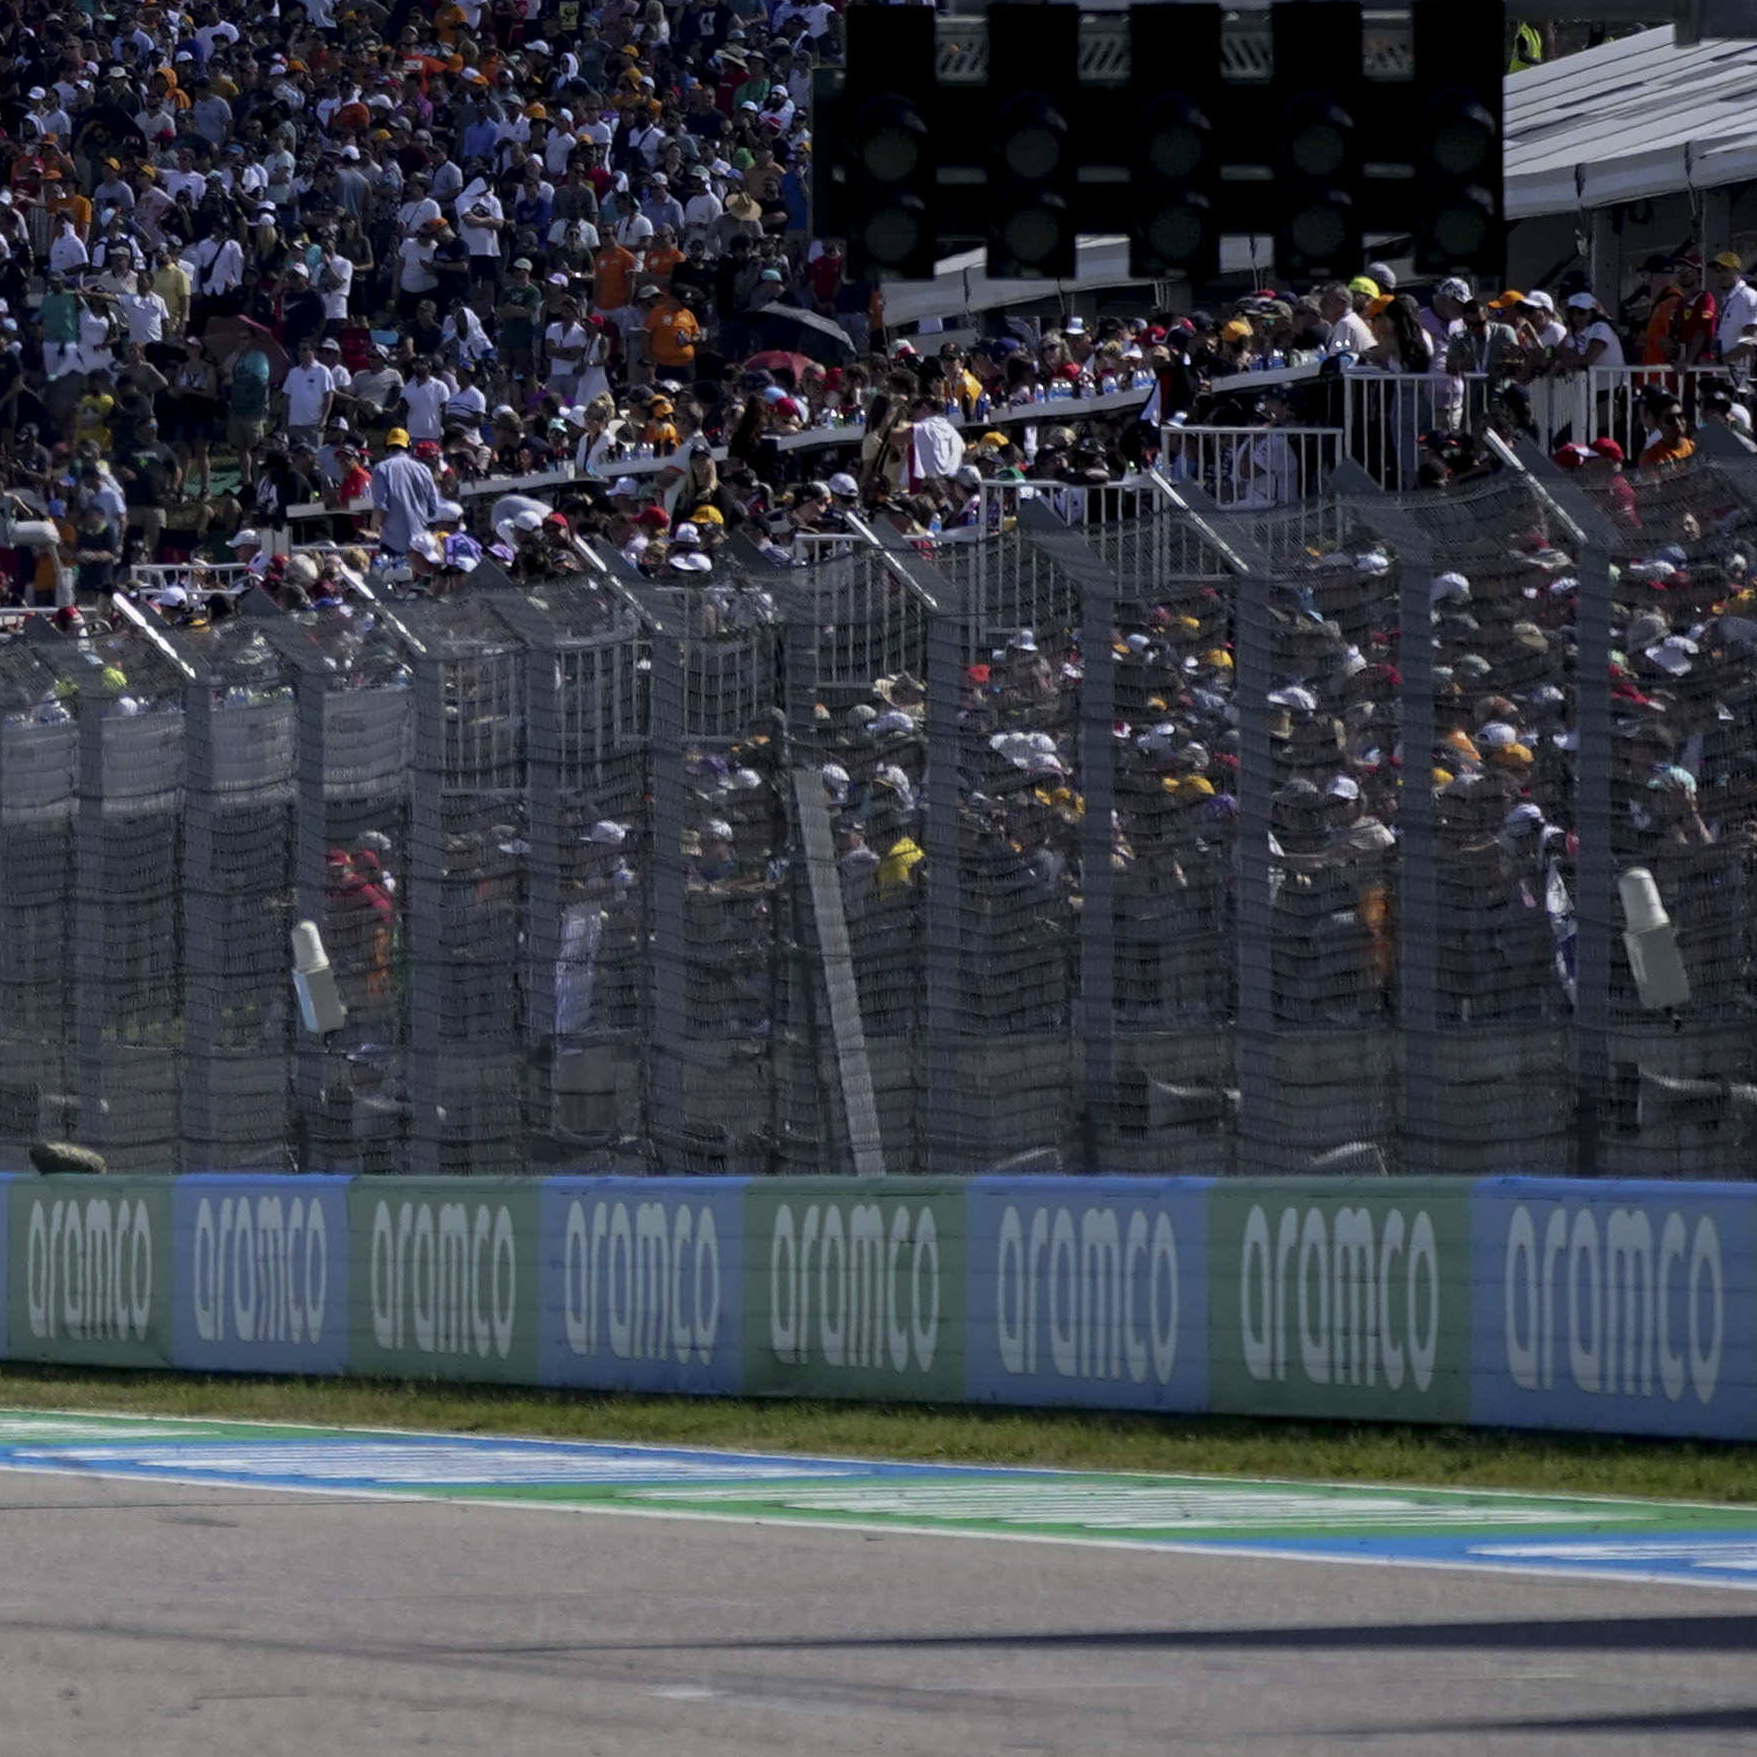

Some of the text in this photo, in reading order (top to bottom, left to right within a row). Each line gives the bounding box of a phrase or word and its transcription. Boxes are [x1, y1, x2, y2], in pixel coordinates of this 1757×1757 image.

[27, 1197, 152, 1342] aramco
[194, 1197, 327, 1346] aramco
[370, 1200, 516, 1360] aramco
[565, 1200, 721, 1366] aramco
[770, 1203, 940, 1372] aramco
[996, 1205, 1180, 1384] aramco
[1240, 1205, 1439, 1392] aramco
[1503, 1205, 1724, 1403] aramco
